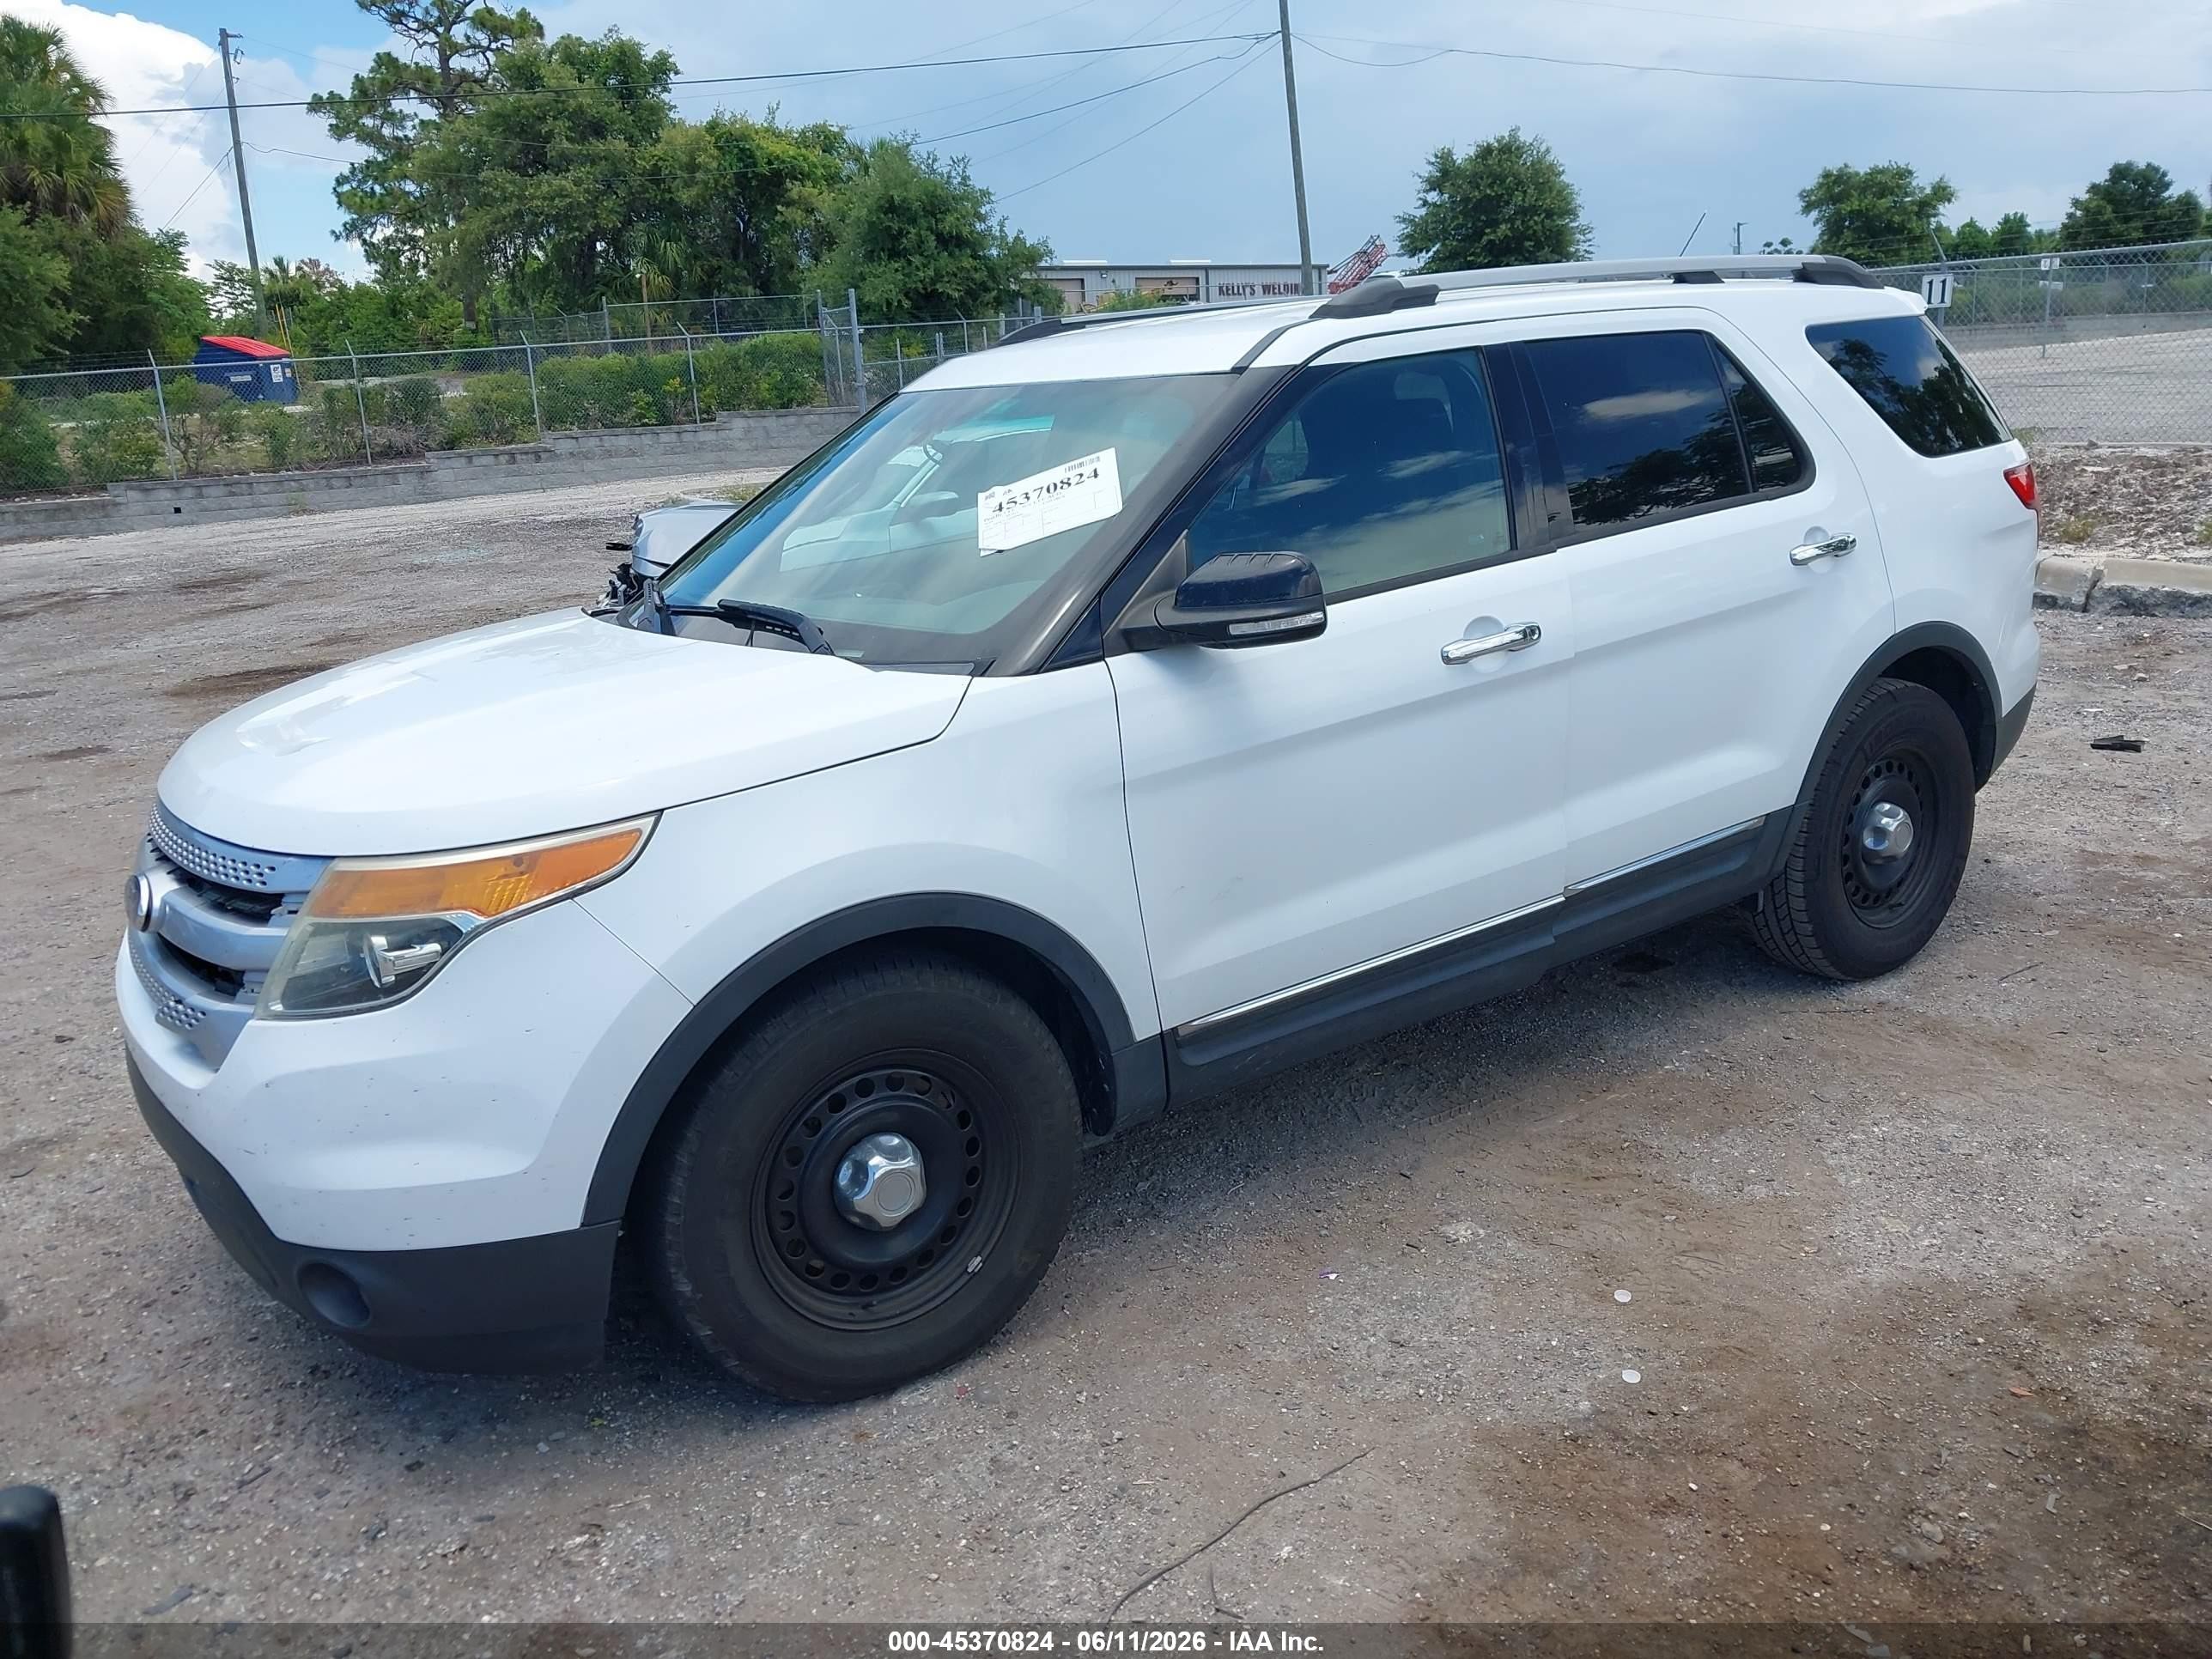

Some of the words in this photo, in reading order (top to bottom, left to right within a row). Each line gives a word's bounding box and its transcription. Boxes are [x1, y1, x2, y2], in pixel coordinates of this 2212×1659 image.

[1261, 283, 1300, 296] WELDIN
[1926, 277, 1948, 305] 11
[992, 467, 1100, 514] 45370824
